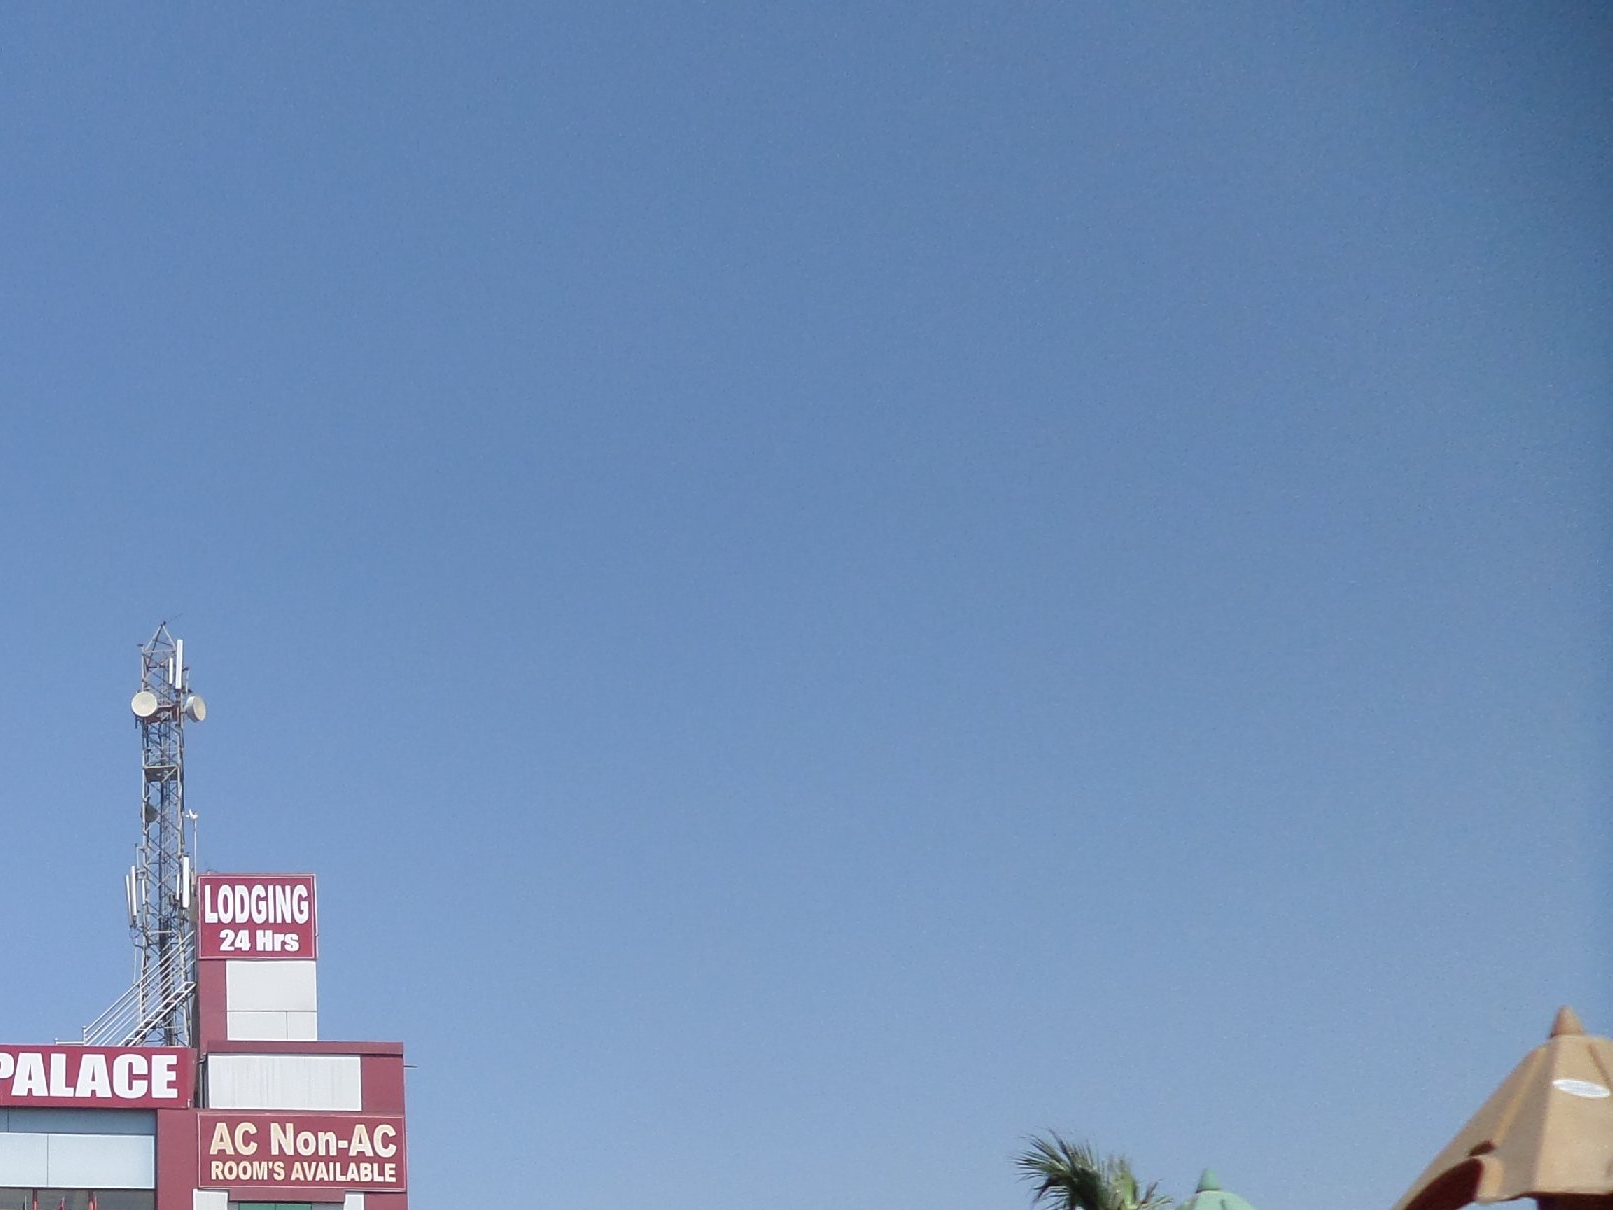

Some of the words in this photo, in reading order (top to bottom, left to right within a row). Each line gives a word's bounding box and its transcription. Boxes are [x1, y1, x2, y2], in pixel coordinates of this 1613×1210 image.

[204, 884, 309, 925] LODGING
[219, 929, 251, 951] 24
[255, 929, 299, 952] Hrs
[209, 1122, 258, 1156] AC
[270, 1122, 397, 1158] Non-AC
[211, 1160, 285, 1181] ROOM'S
[290, 1161, 397, 1183] AVAILABLE
